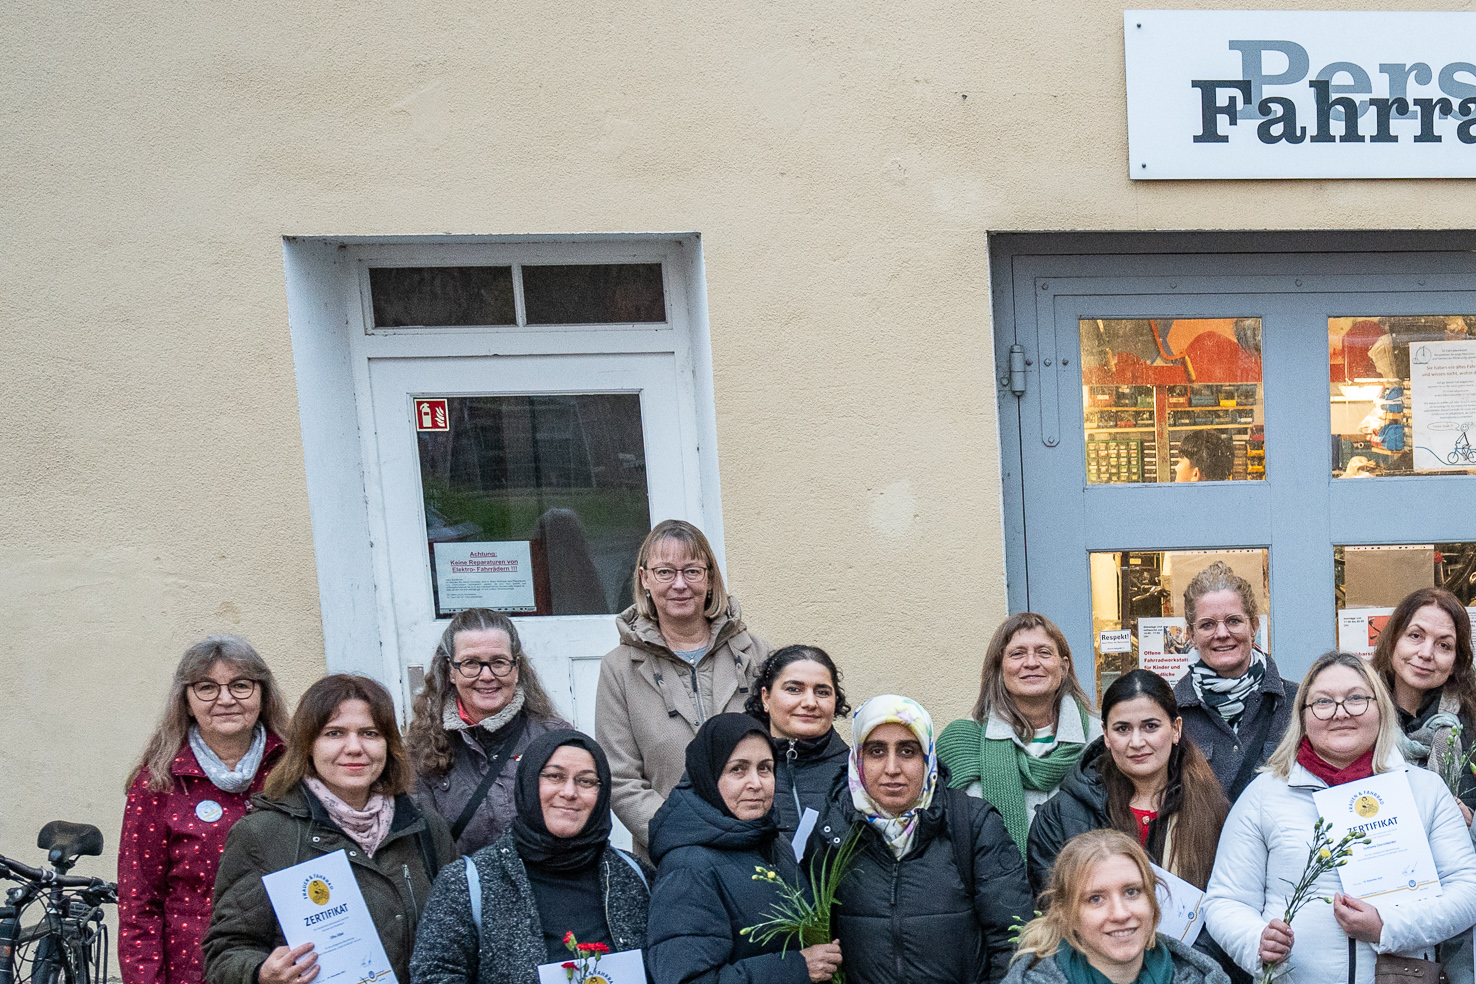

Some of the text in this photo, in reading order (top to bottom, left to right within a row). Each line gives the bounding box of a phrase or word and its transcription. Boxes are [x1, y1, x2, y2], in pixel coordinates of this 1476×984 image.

[1349, 794, 1358, 813] FRAUEN
[1363, 790, 1385, 806] FAHRRAD
[304, 903, 349, 927] ZERTIFIKAT
